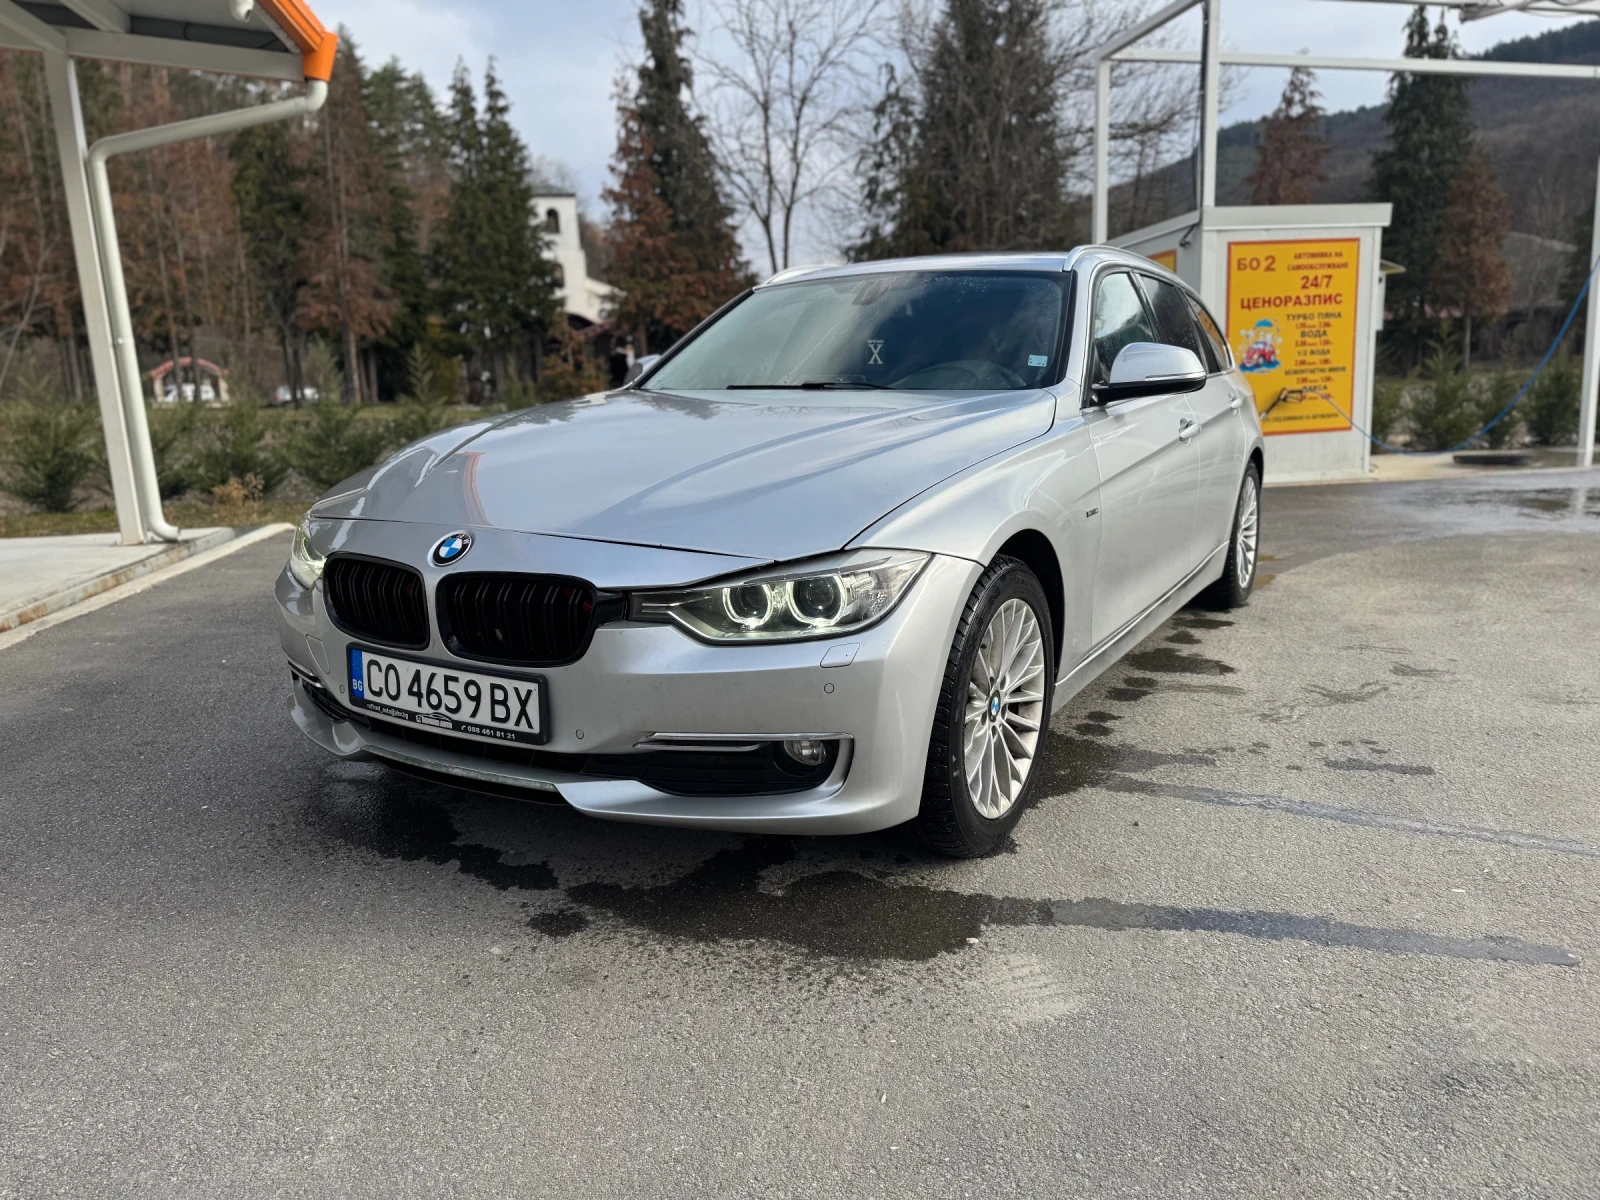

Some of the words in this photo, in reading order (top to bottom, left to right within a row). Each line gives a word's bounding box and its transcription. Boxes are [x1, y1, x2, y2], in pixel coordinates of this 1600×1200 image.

[1264, 255, 1276, 272] 2
[1301, 274, 1333, 290] 24/7
[1240, 293, 1343, 311] ЦЕНОРАЗПИС
[1286, 313, 1315, 321] ТУРБО
[1317, 311, 1342, 319] ПЯНА
[1300, 329, 1328, 339] ВОДА
[867, 343, 884, 365] X
[1310, 348, 1331, 356] ВОДА
[352, 678, 363, 691] BG
[407, 669, 482, 718] 4659
[507, 732, 516, 740] 21
